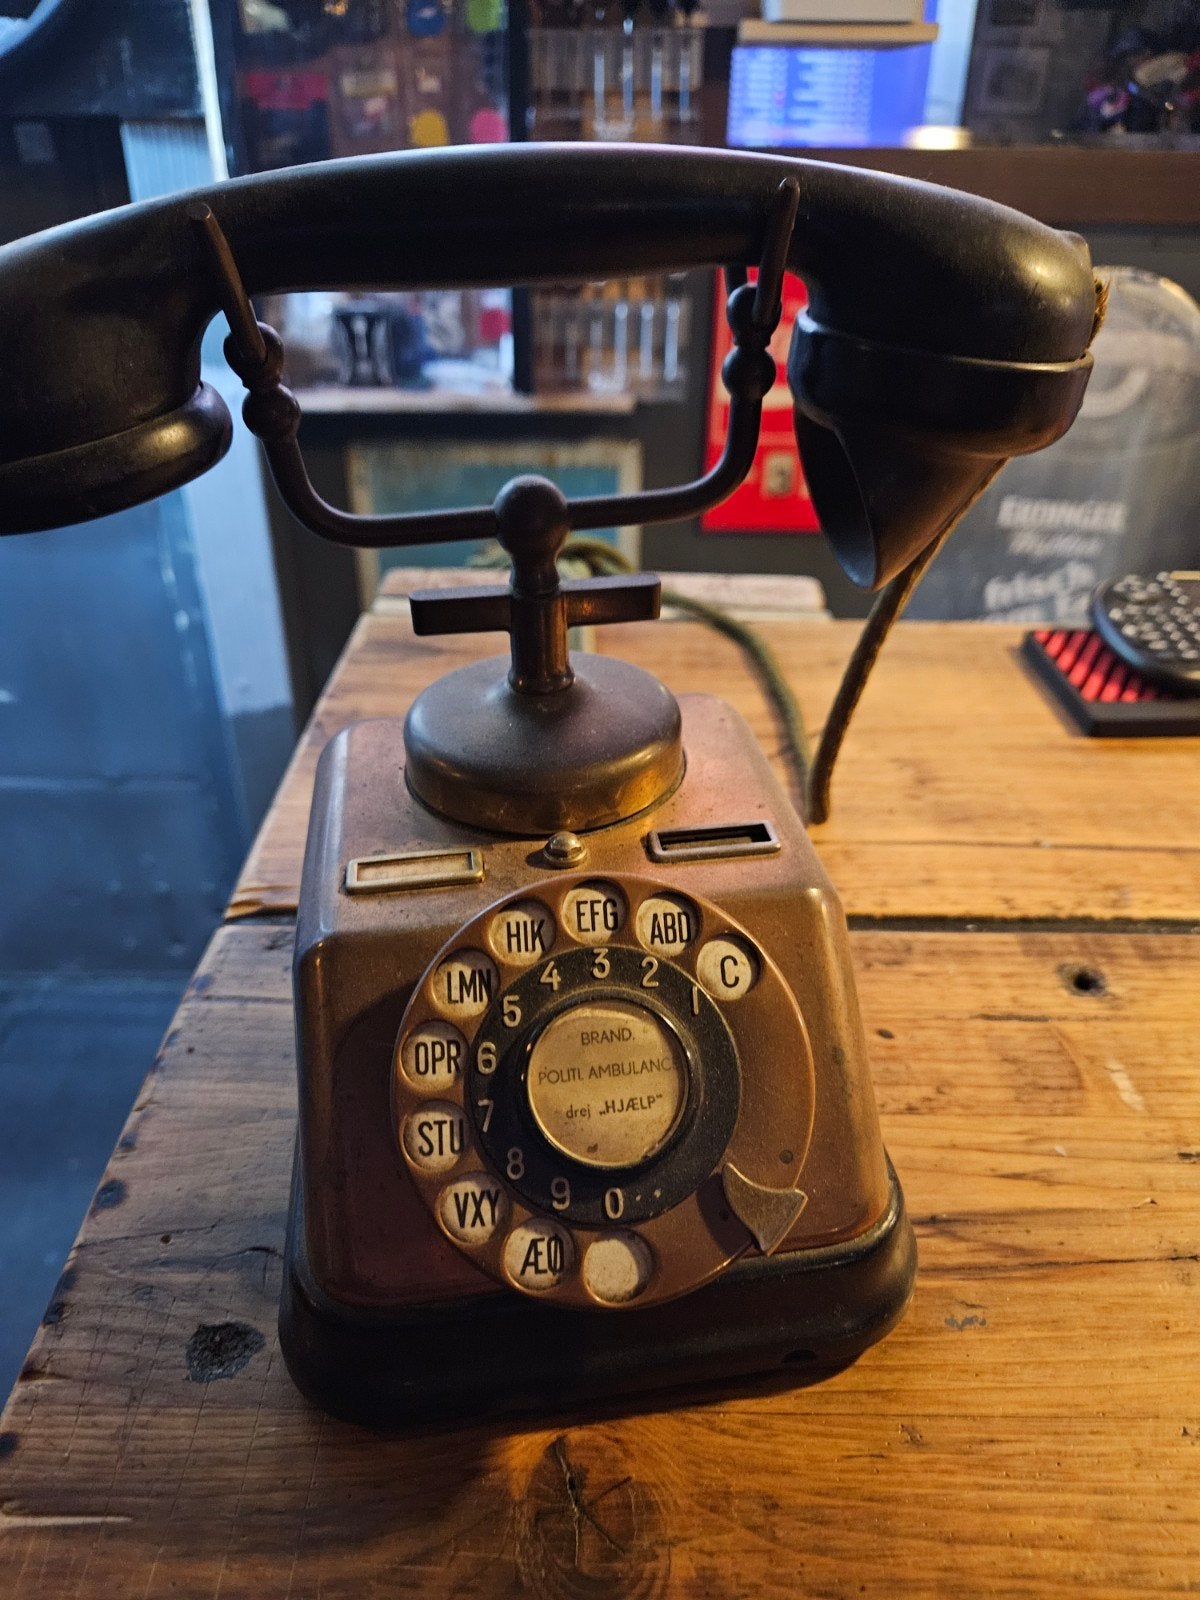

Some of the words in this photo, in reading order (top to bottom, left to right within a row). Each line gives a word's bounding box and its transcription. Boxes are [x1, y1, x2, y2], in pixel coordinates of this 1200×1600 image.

[576, 899, 618, 933] EFG
[650, 911, 692, 945] ABD
[506, 919, 546, 953] HIK
[539, 960, 562, 991] 4
[592, 948, 611, 980] 3
[641, 956, 659, 988] 2
[720, 955, 740, 988] C
[446, 968, 492, 1004] LMN
[502, 994, 522, 1028] 5
[580, 1027, 636, 1046] BRAND.
[414, 1039, 461, 1076] OPR
[477, 1041, 497, 1075] 6
[588, 1056, 677, 1080] AMBULANC
[477, 1099, 494, 1133] 7
[566, 1104, 591, 1120] drej
[417, 1118, 464, 1157] STU
[506, 1147, 525, 1180] 8
[453, 1189, 500, 1229] VXY
[551, 1177, 571, 1211] 9
[605, 1187, 624, 1219] 0
[520, 1233, 565, 1276] ÆØ
